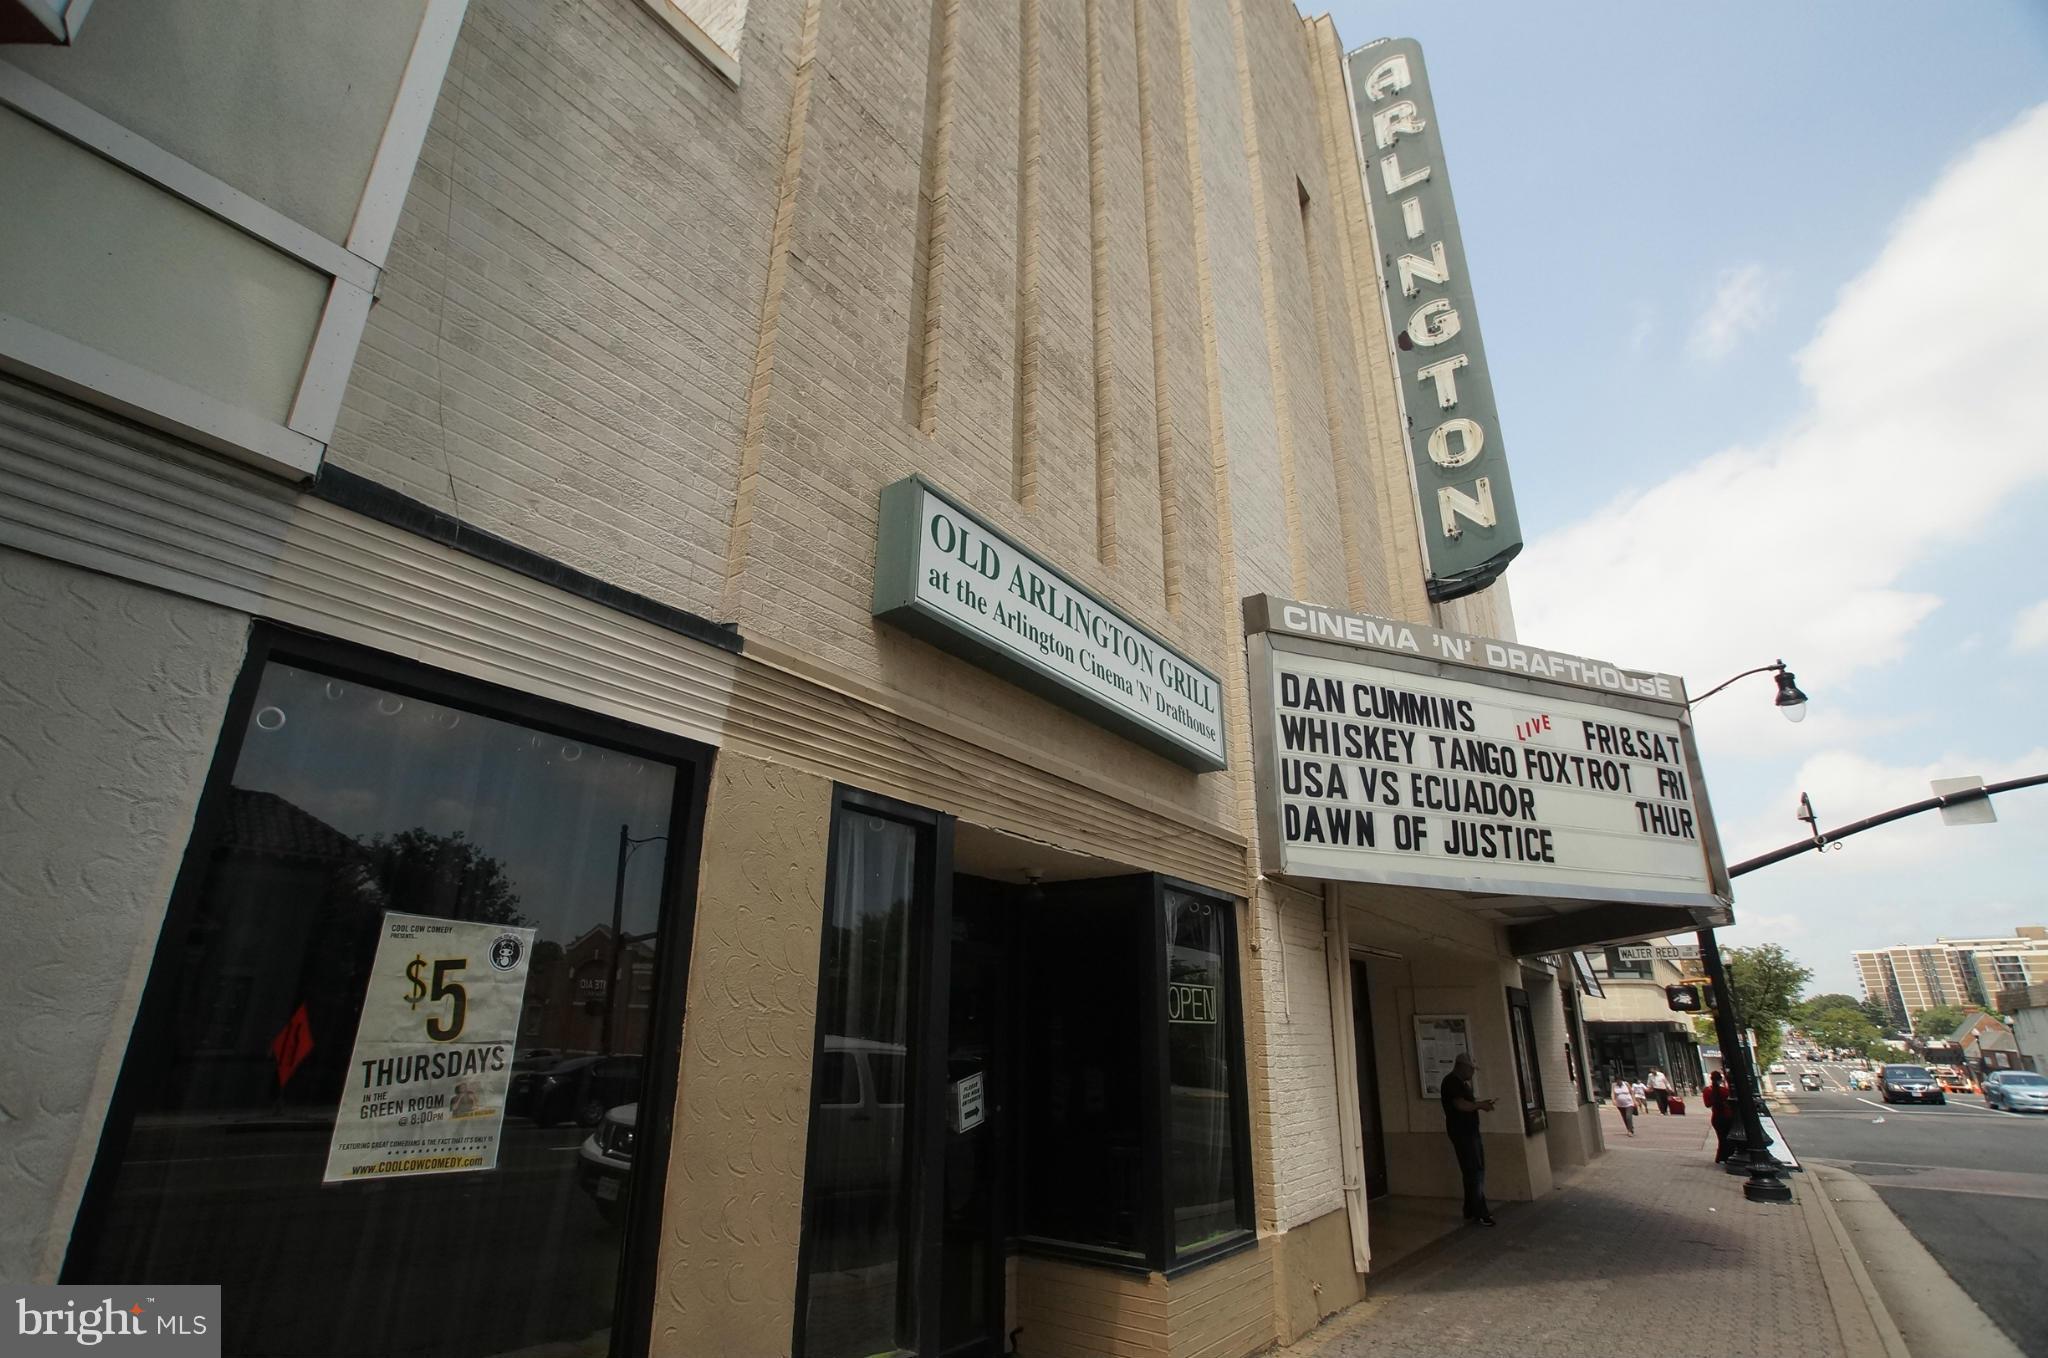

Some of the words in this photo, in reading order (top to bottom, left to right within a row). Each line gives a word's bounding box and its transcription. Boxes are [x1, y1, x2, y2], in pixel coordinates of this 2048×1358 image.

[1364, 53, 1497, 539] ARLINGTON
[930, 514, 1000, 581] OLD
[1008, 564, 1154, 677] ARLINGTON
[1159, 658, 1215, 714] GRILL
[928, 566, 950, 594] at
[956, 578, 988, 614] the
[993, 601, 1074, 664] Arlington
[1079, 650, 1133, 697] Cinema
[1136, 679, 1153, 704] 'N'
[1156, 691, 1217, 742] Drafthouse
[1283, 605, 1420, 652] CINEMA
[1485, 644, 1673, 699] DRAFTHOUSE
[1281, 672, 1346, 714] DAN
[1353, 684, 1475, 732] CUMMINS
[1516, 714, 1551, 741] LIVE
[1582, 721, 1679, 765] FRI&SAT
[1280, 714, 1415, 764] WHISKEY
[1429, 735, 1518, 779] TANGO
[1523, 748, 1632, 793] FOXTROT
[1657, 768, 1688, 800] FRI
[1282, 758, 1348, 799] USA
[1359, 766, 1400, 806] VS
[1411, 773, 1536, 821] ECUADOR
[1635, 801, 1695, 839] THUR
[1284, 804, 1375, 847] DAWN
[1394, 815, 1427, 851] OF
[1444, 820, 1554, 863] JUSTICE
[391, 924, 409, 933] COOL
[410, 925, 425, 933] COW
[427, 926, 454, 934] COMEDY
[1620, 948, 1652, 959] WALTER
[1655, 947, 1679, 958] REED
[403, 954, 467, 1042] $5
[1169, 986, 1215, 1020] OPEN
[361, 1045, 505, 1088] THURSDAYS
[360, 1100, 404, 1119] GREEN
[408, 1094, 445, 1112] ROOM
[363, 1094, 371, 1102] IN
[373, 1091, 388, 1101] THE
[338, 1142, 371, 1150] FEATURING
[371, 1141, 389, 1149] GREAT
[389, 1139, 421, 1148] COMEDIANS
[352, 1156, 483, 1175] www.COOLCOWCOMEDY.com
